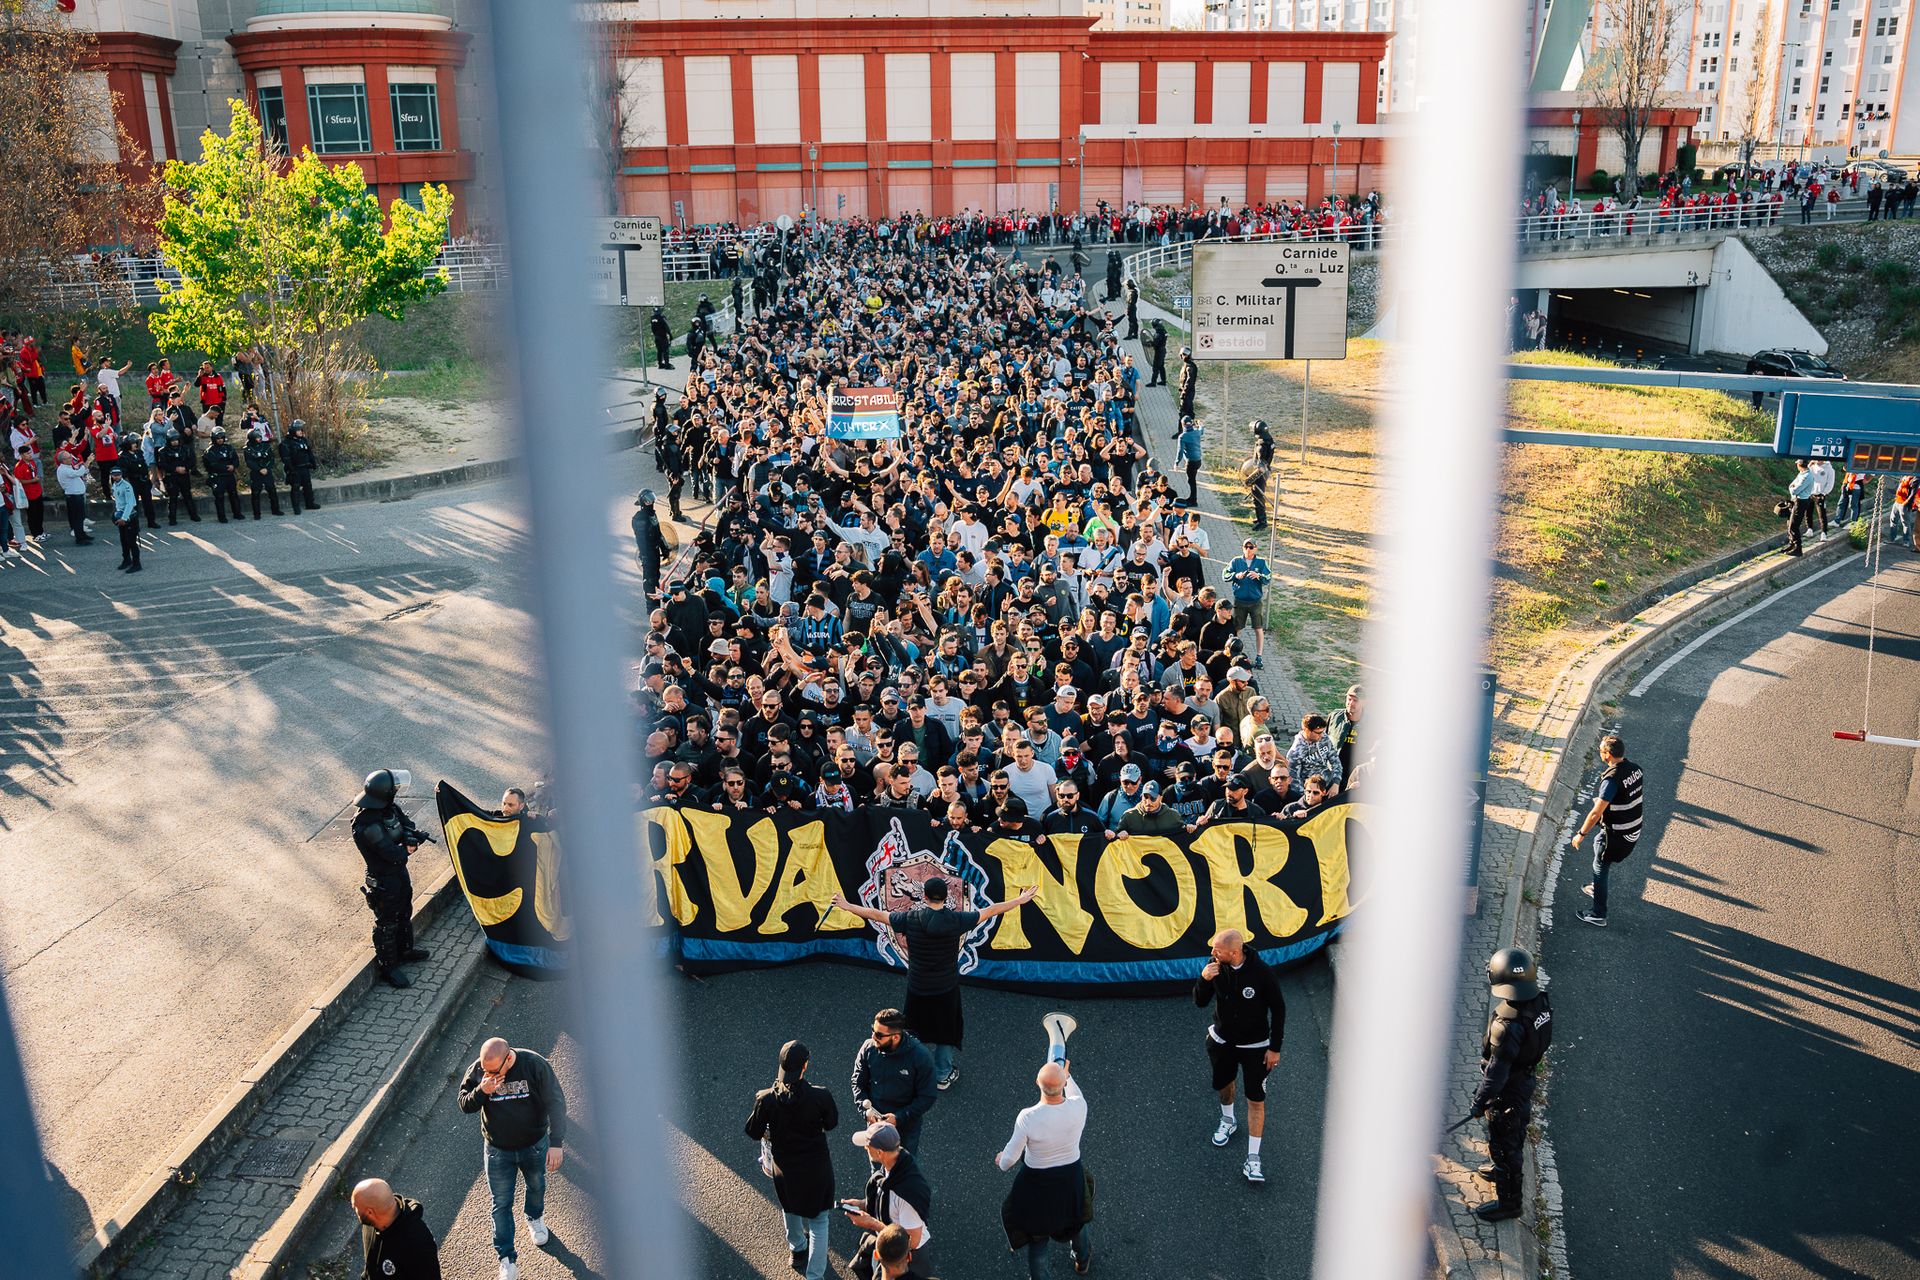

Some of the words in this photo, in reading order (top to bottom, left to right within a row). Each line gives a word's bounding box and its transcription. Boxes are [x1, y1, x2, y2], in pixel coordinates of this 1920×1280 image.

[613, 220, 652, 229] Carnide
[640, 232, 658, 241] Luz
[1282, 247, 1338, 259] Carnide
[1319, 262, 1344, 274] Luz
[1216, 295, 1230, 306] C.
[1236, 295, 1282, 306] Militar
[1216, 314, 1275, 325] terminal
[1218, 336, 1264, 347] estádio
[1814, 436, 1842, 444] PISO
